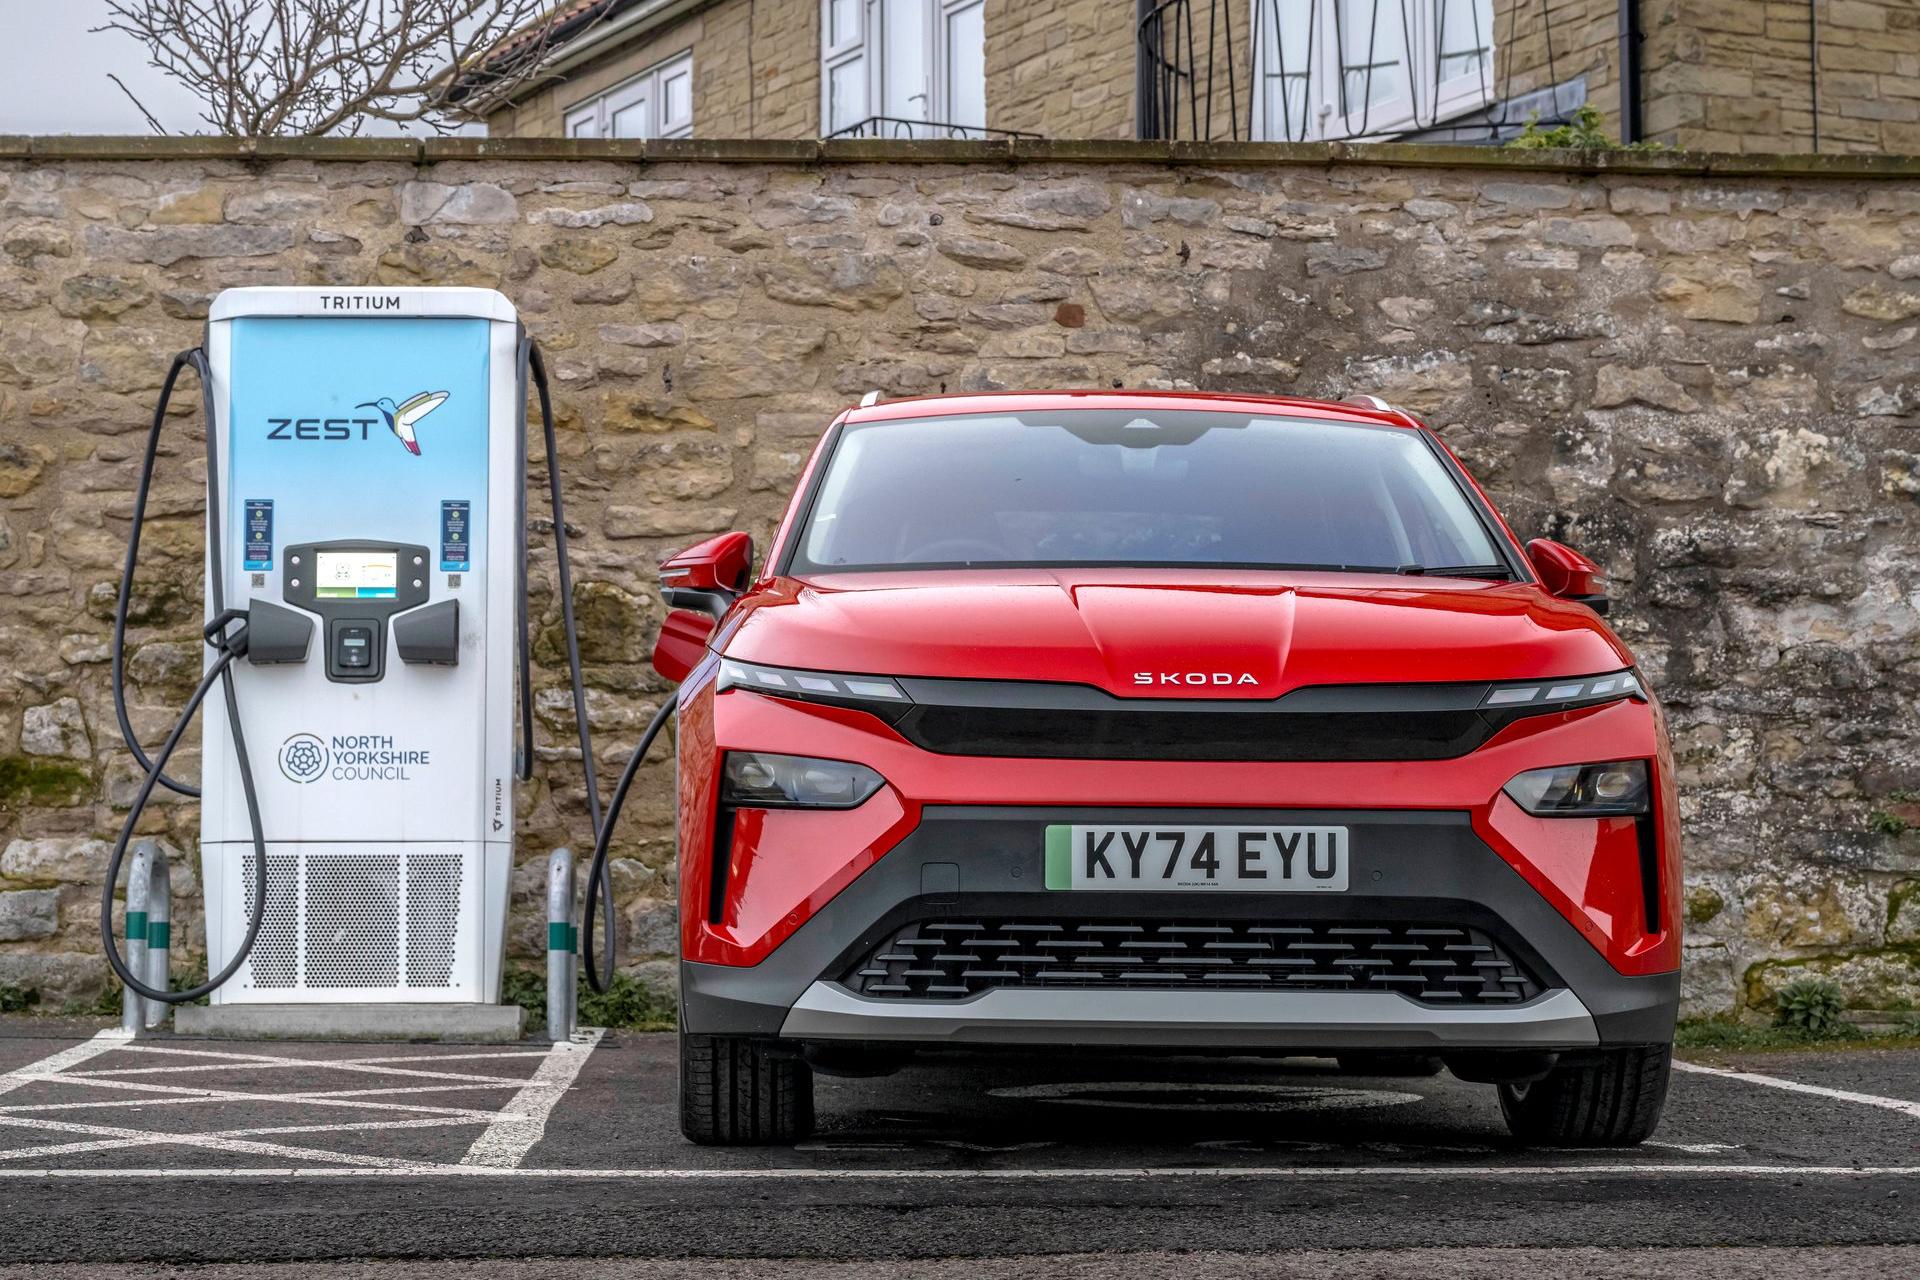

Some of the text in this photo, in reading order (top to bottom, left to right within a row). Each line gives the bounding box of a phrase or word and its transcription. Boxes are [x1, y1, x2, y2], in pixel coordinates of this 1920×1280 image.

[320, 296, 400, 309] TRITIUM
[267, 418, 379, 440] ZEST
[332, 735, 393, 749] NORTH
[332, 751, 430, 765] YORKSHIRE
[332, 766, 410, 780] COUNCIL
[1086, 831, 1337, 880] KY74 EYU
